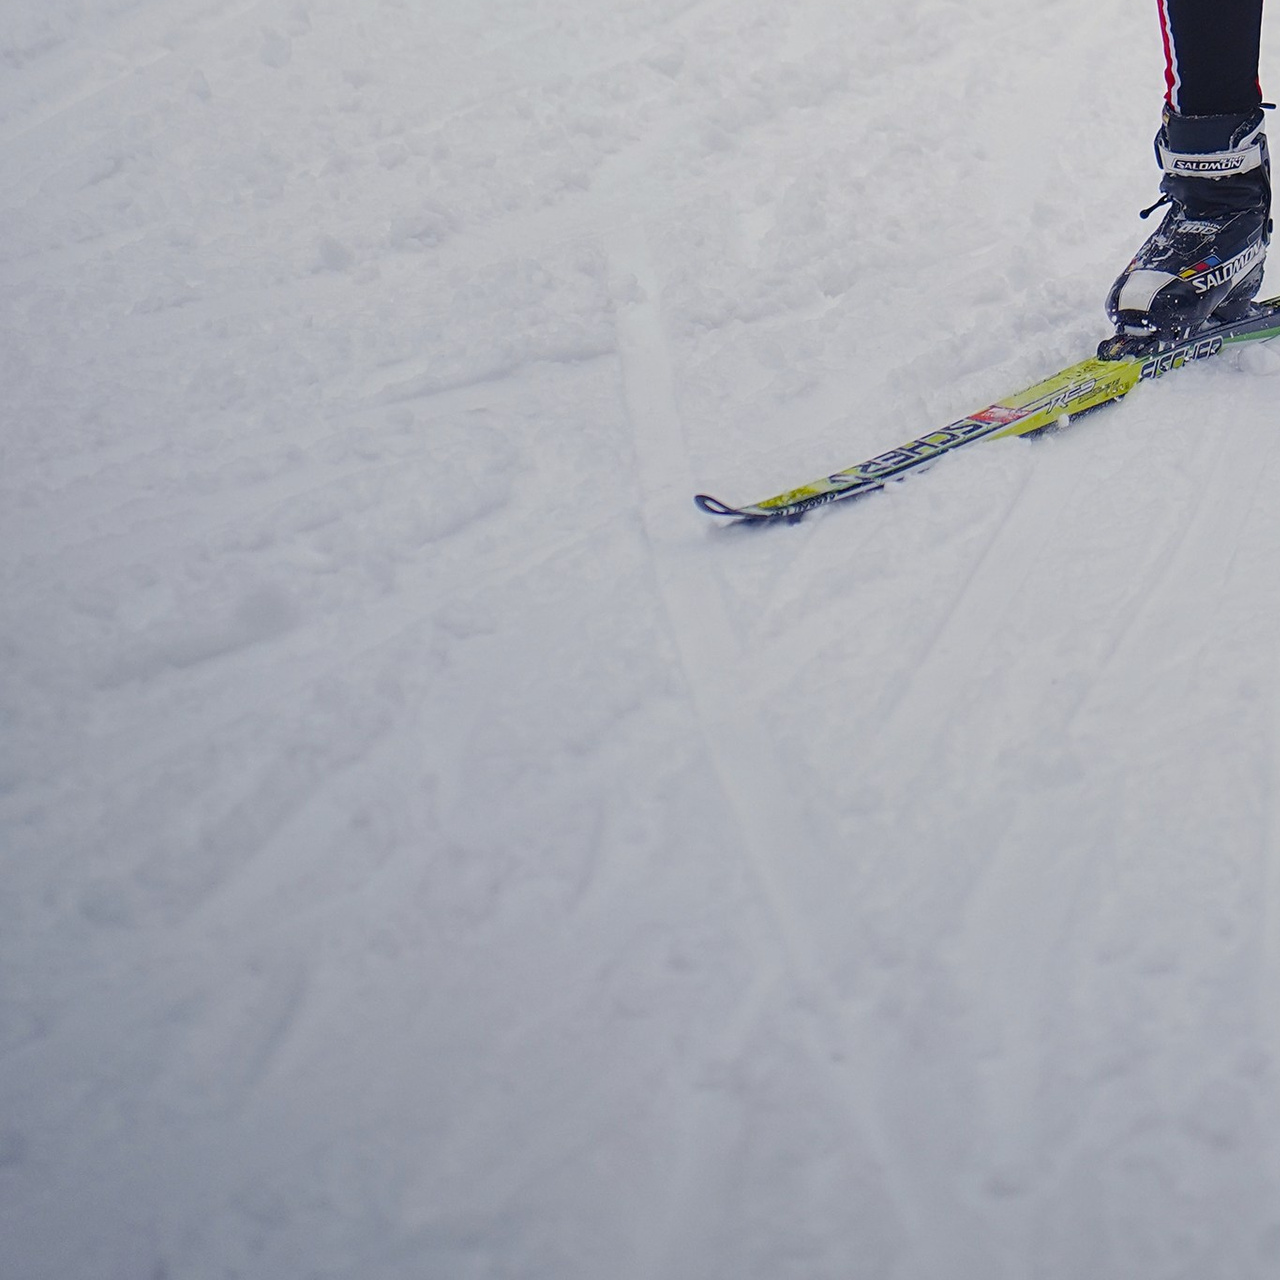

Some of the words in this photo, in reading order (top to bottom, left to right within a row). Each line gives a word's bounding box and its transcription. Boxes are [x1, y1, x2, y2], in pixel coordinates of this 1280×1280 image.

[1175, 158, 1242, 171] SALOMON
[1191, 239, 1263, 294] SALOMON
[857, 416, 992, 474] ISCHER
